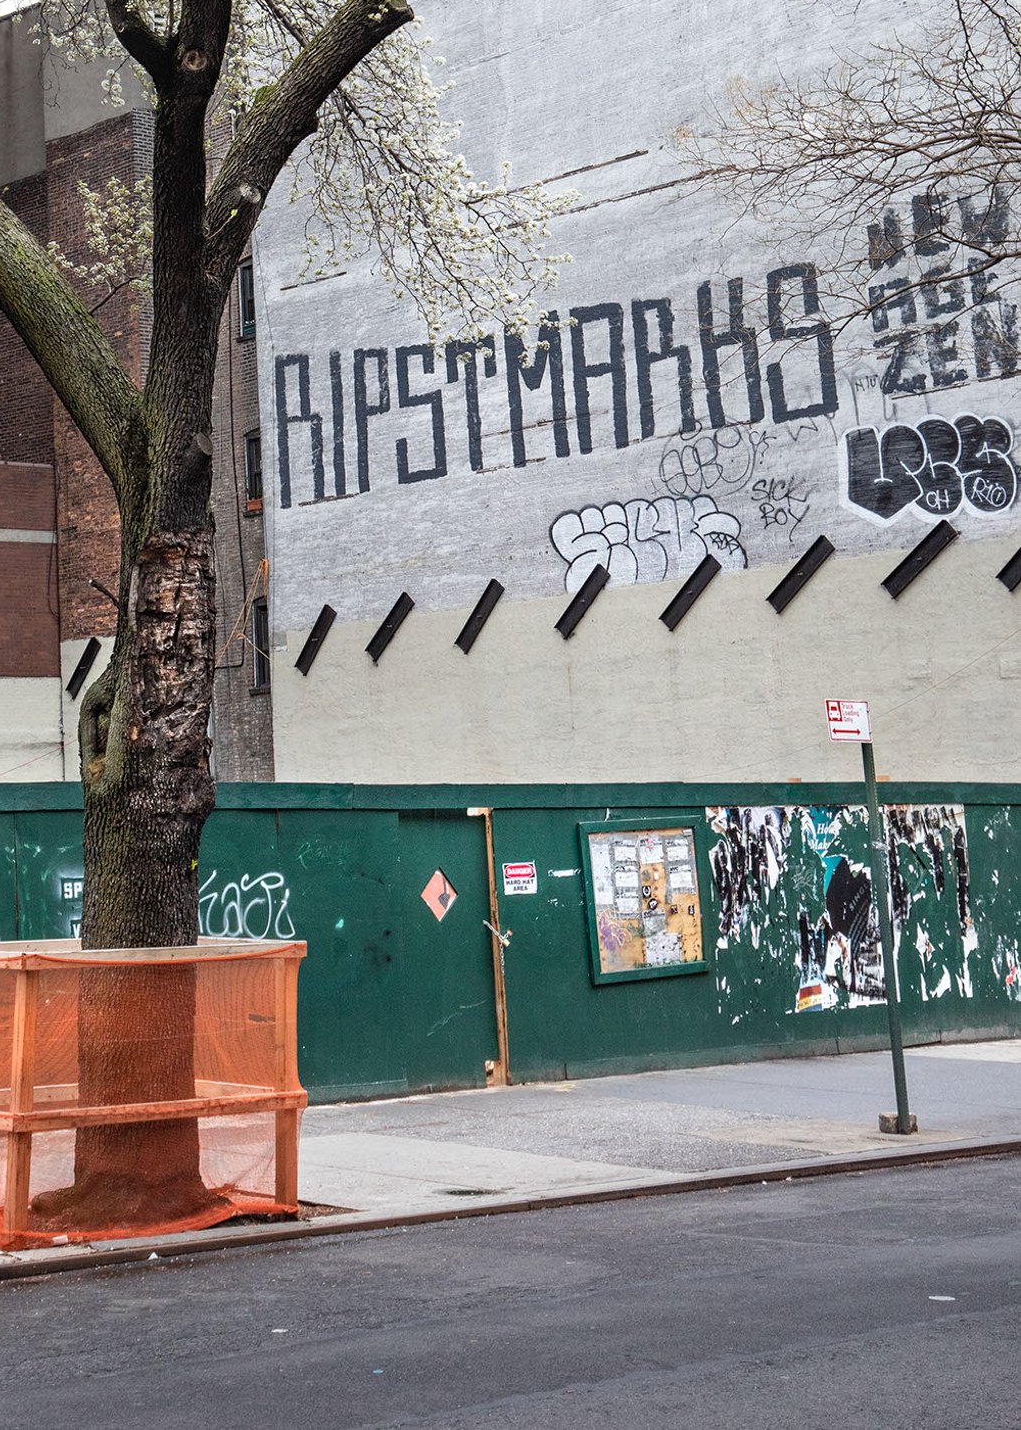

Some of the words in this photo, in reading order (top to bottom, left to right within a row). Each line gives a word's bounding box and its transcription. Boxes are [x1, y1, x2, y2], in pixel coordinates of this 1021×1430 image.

[751, 475, 815, 506] SICK
[759, 502, 810, 542] BOY
[508, 867, 532, 875] DANGER
